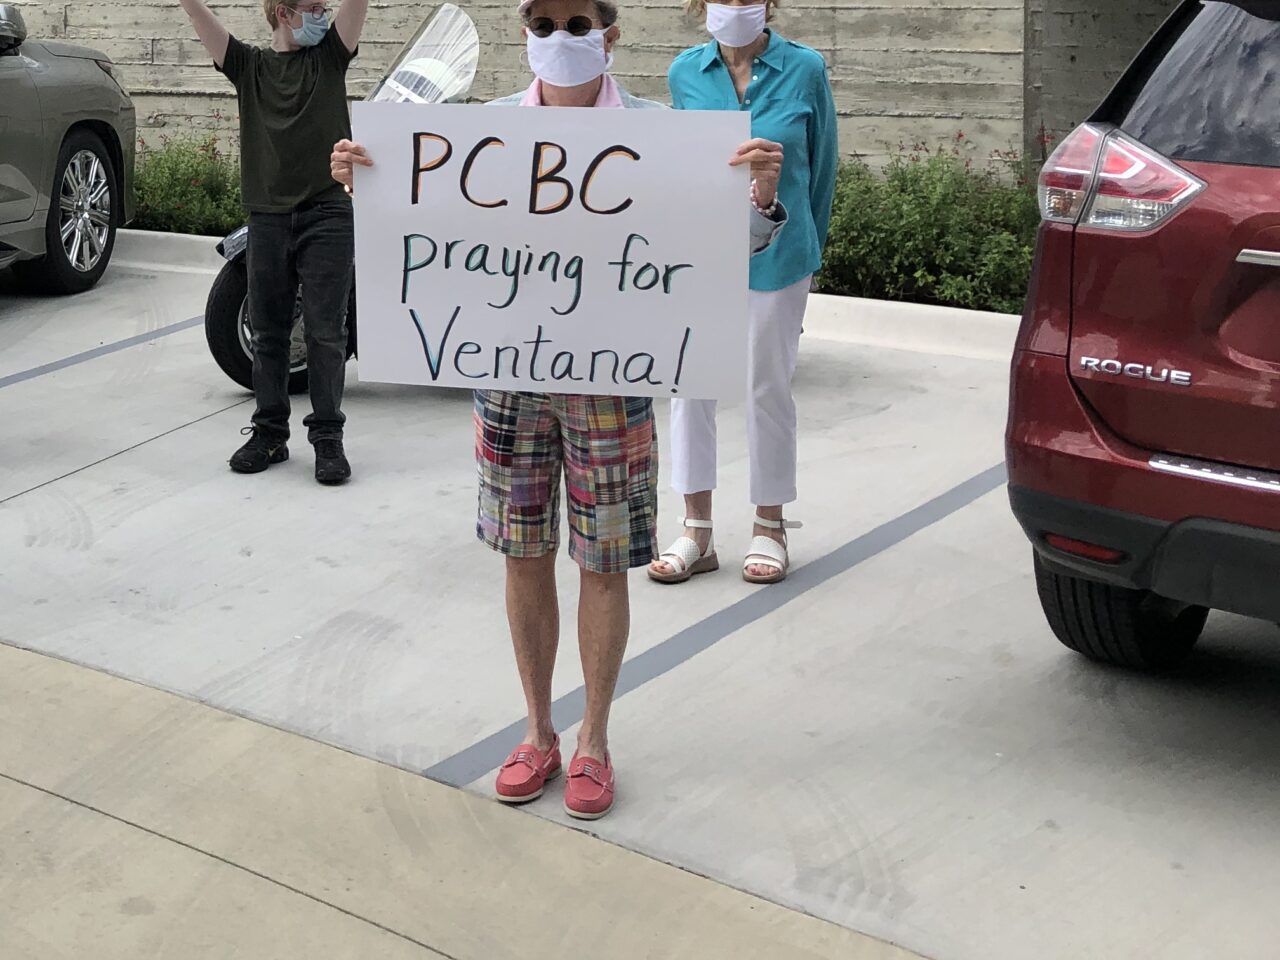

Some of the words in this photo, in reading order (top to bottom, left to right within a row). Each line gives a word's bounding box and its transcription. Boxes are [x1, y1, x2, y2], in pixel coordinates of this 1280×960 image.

[411, 132, 641, 215] PCBC
[401, 233, 584, 316] praying
[607, 233, 694, 294] for
[409, 306, 691, 393] Ventana!
[1081, 356, 1192, 386] ROGUE
